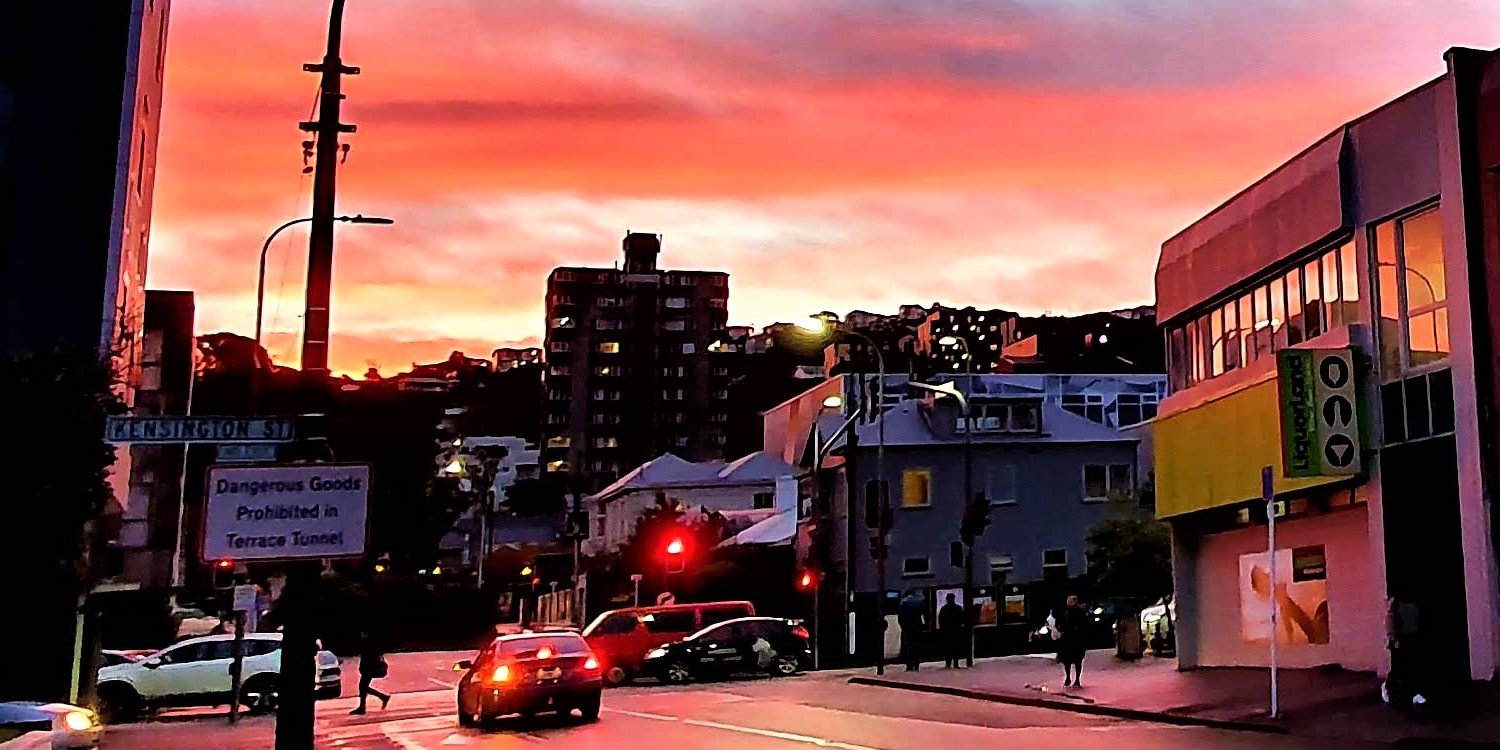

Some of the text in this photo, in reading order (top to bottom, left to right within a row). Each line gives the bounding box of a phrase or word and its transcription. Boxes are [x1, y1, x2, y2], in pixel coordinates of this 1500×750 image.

[114, 420, 287, 438] KENSINGTON ST
[216, 476, 361, 496] Dangerous Goods
[237, 504, 338, 521] Prohibited in
[227, 531, 344, 548] Terrace Tunnel
